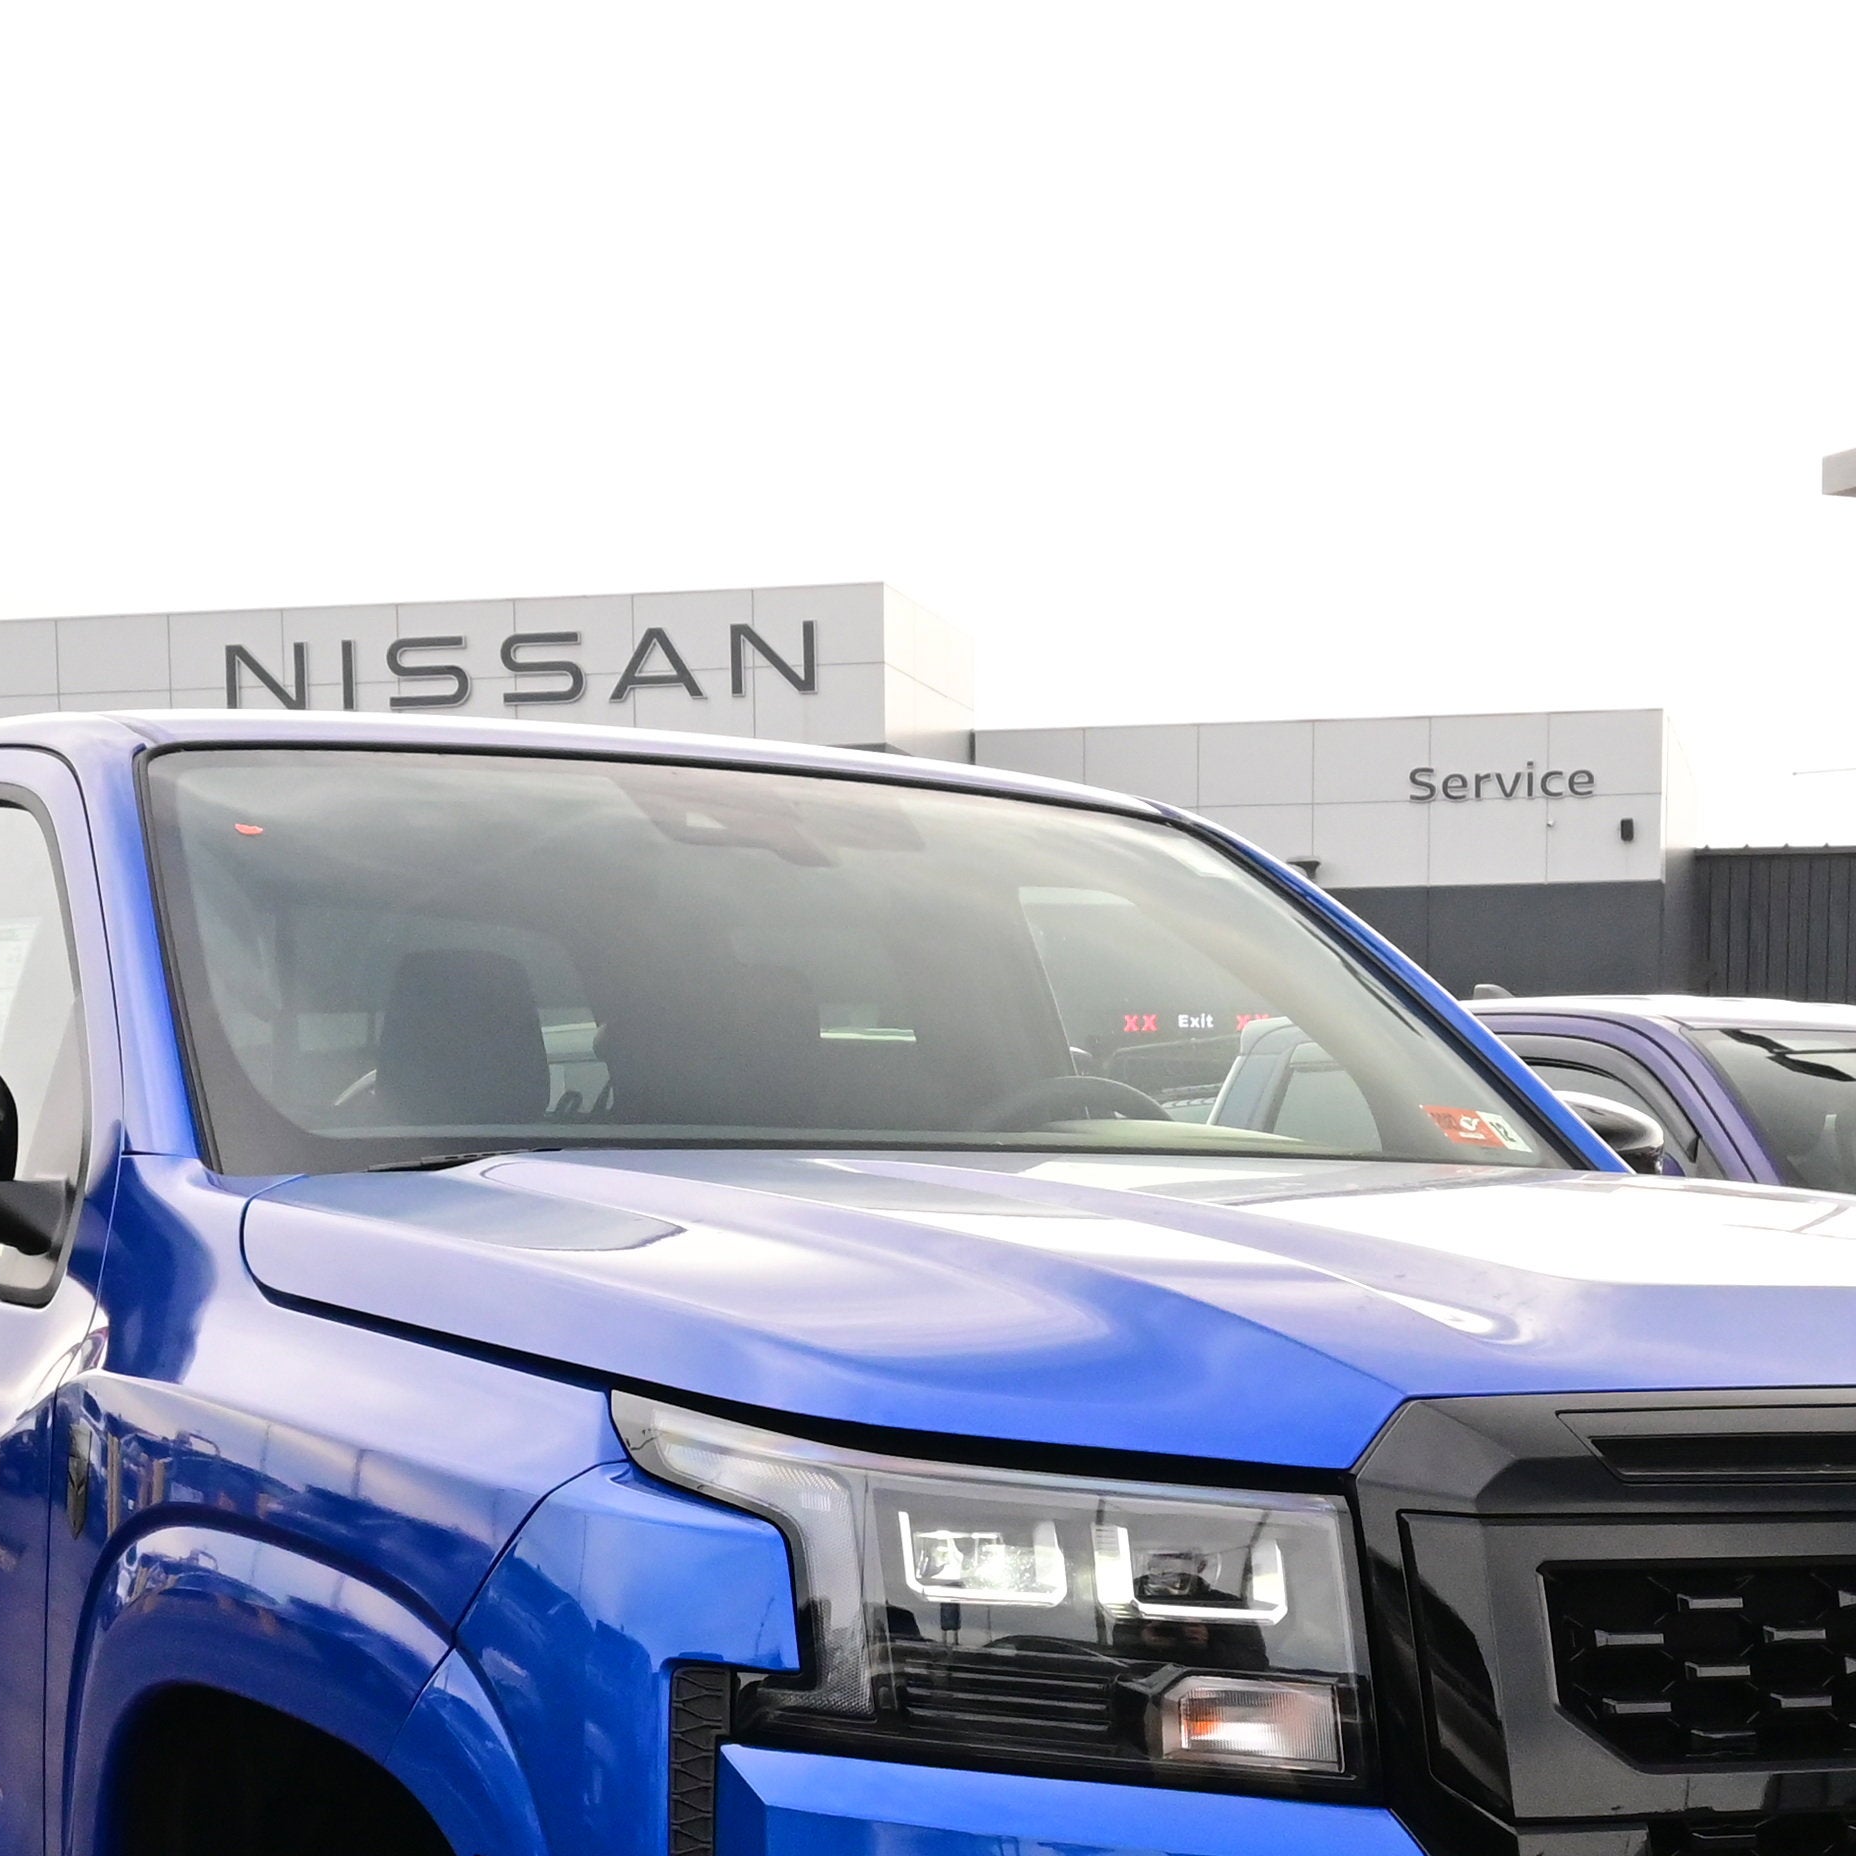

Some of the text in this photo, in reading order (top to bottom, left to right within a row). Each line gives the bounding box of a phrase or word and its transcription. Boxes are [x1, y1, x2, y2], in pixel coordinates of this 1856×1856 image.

[224, 619, 818, 709] NISSAN
[1408, 760, 1595, 803] Service
[1177, 1012, 1214, 1029] Exit
